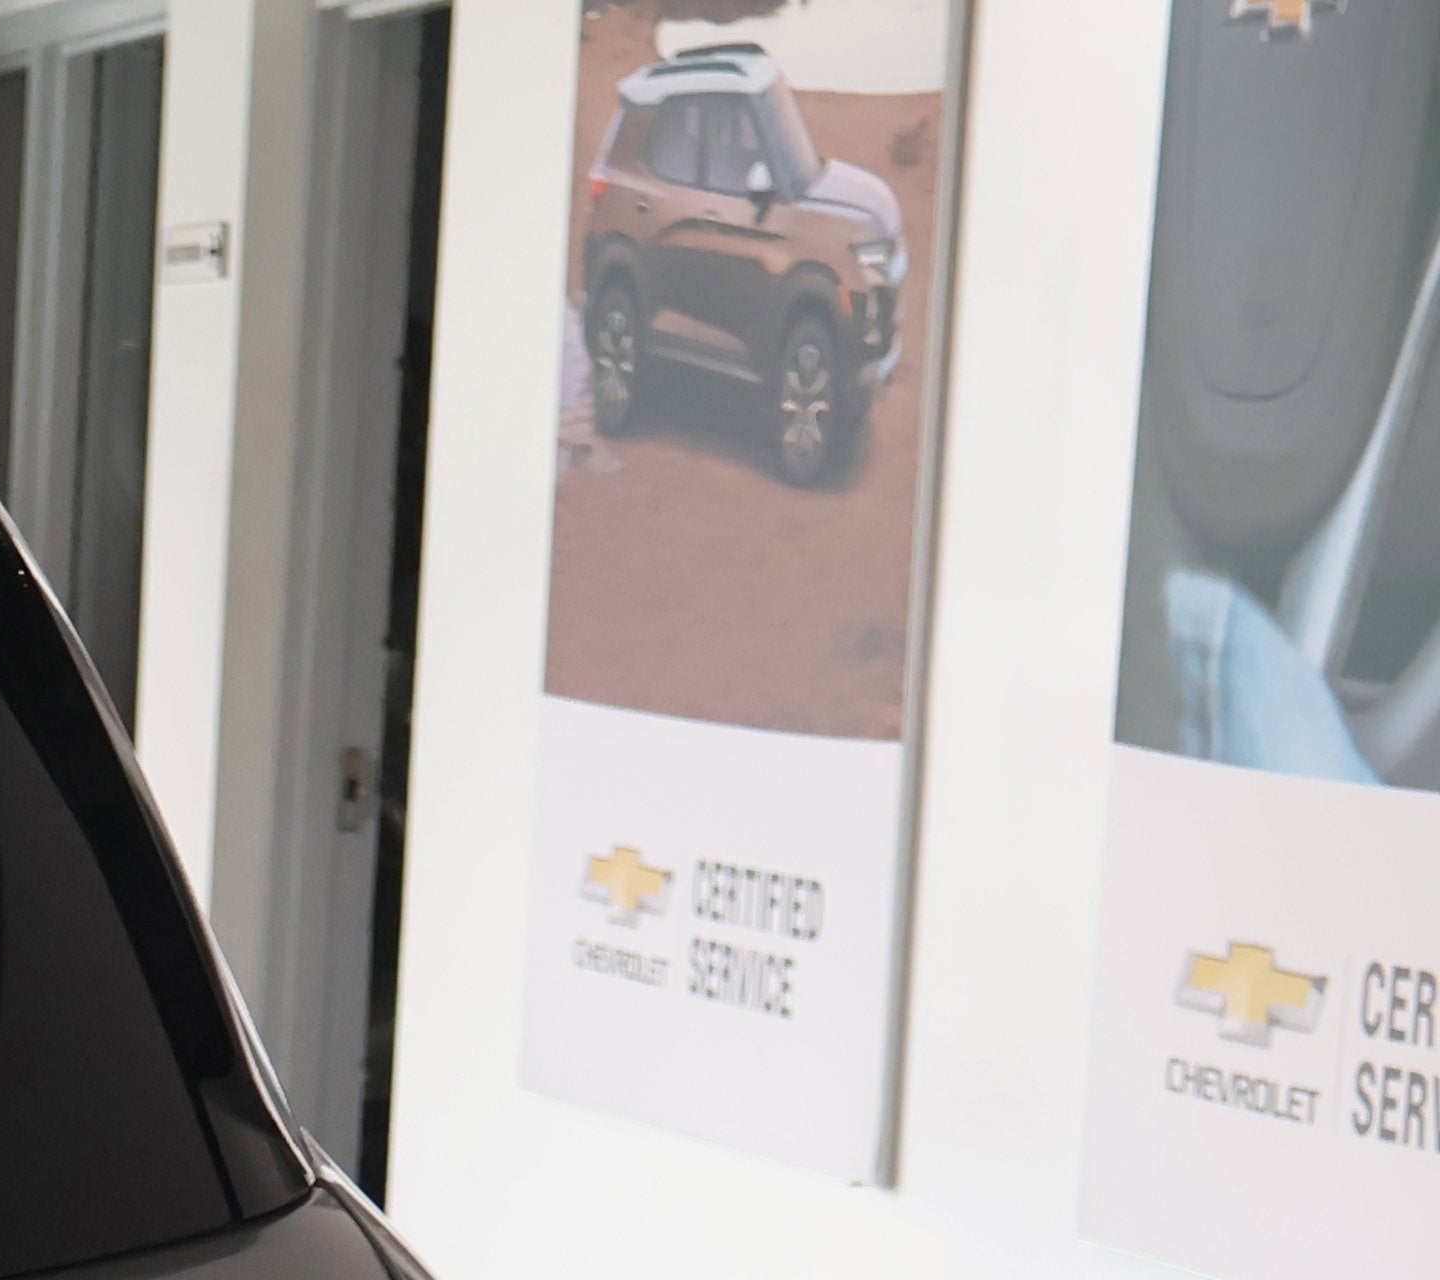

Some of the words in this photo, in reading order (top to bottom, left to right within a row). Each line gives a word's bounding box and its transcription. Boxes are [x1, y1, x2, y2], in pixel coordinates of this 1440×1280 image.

[693, 858, 825, 942] CERTIFIED
[686, 936, 797, 1019] SERVICE
[1164, 1056, 1320, 1125] CHEVROLET
